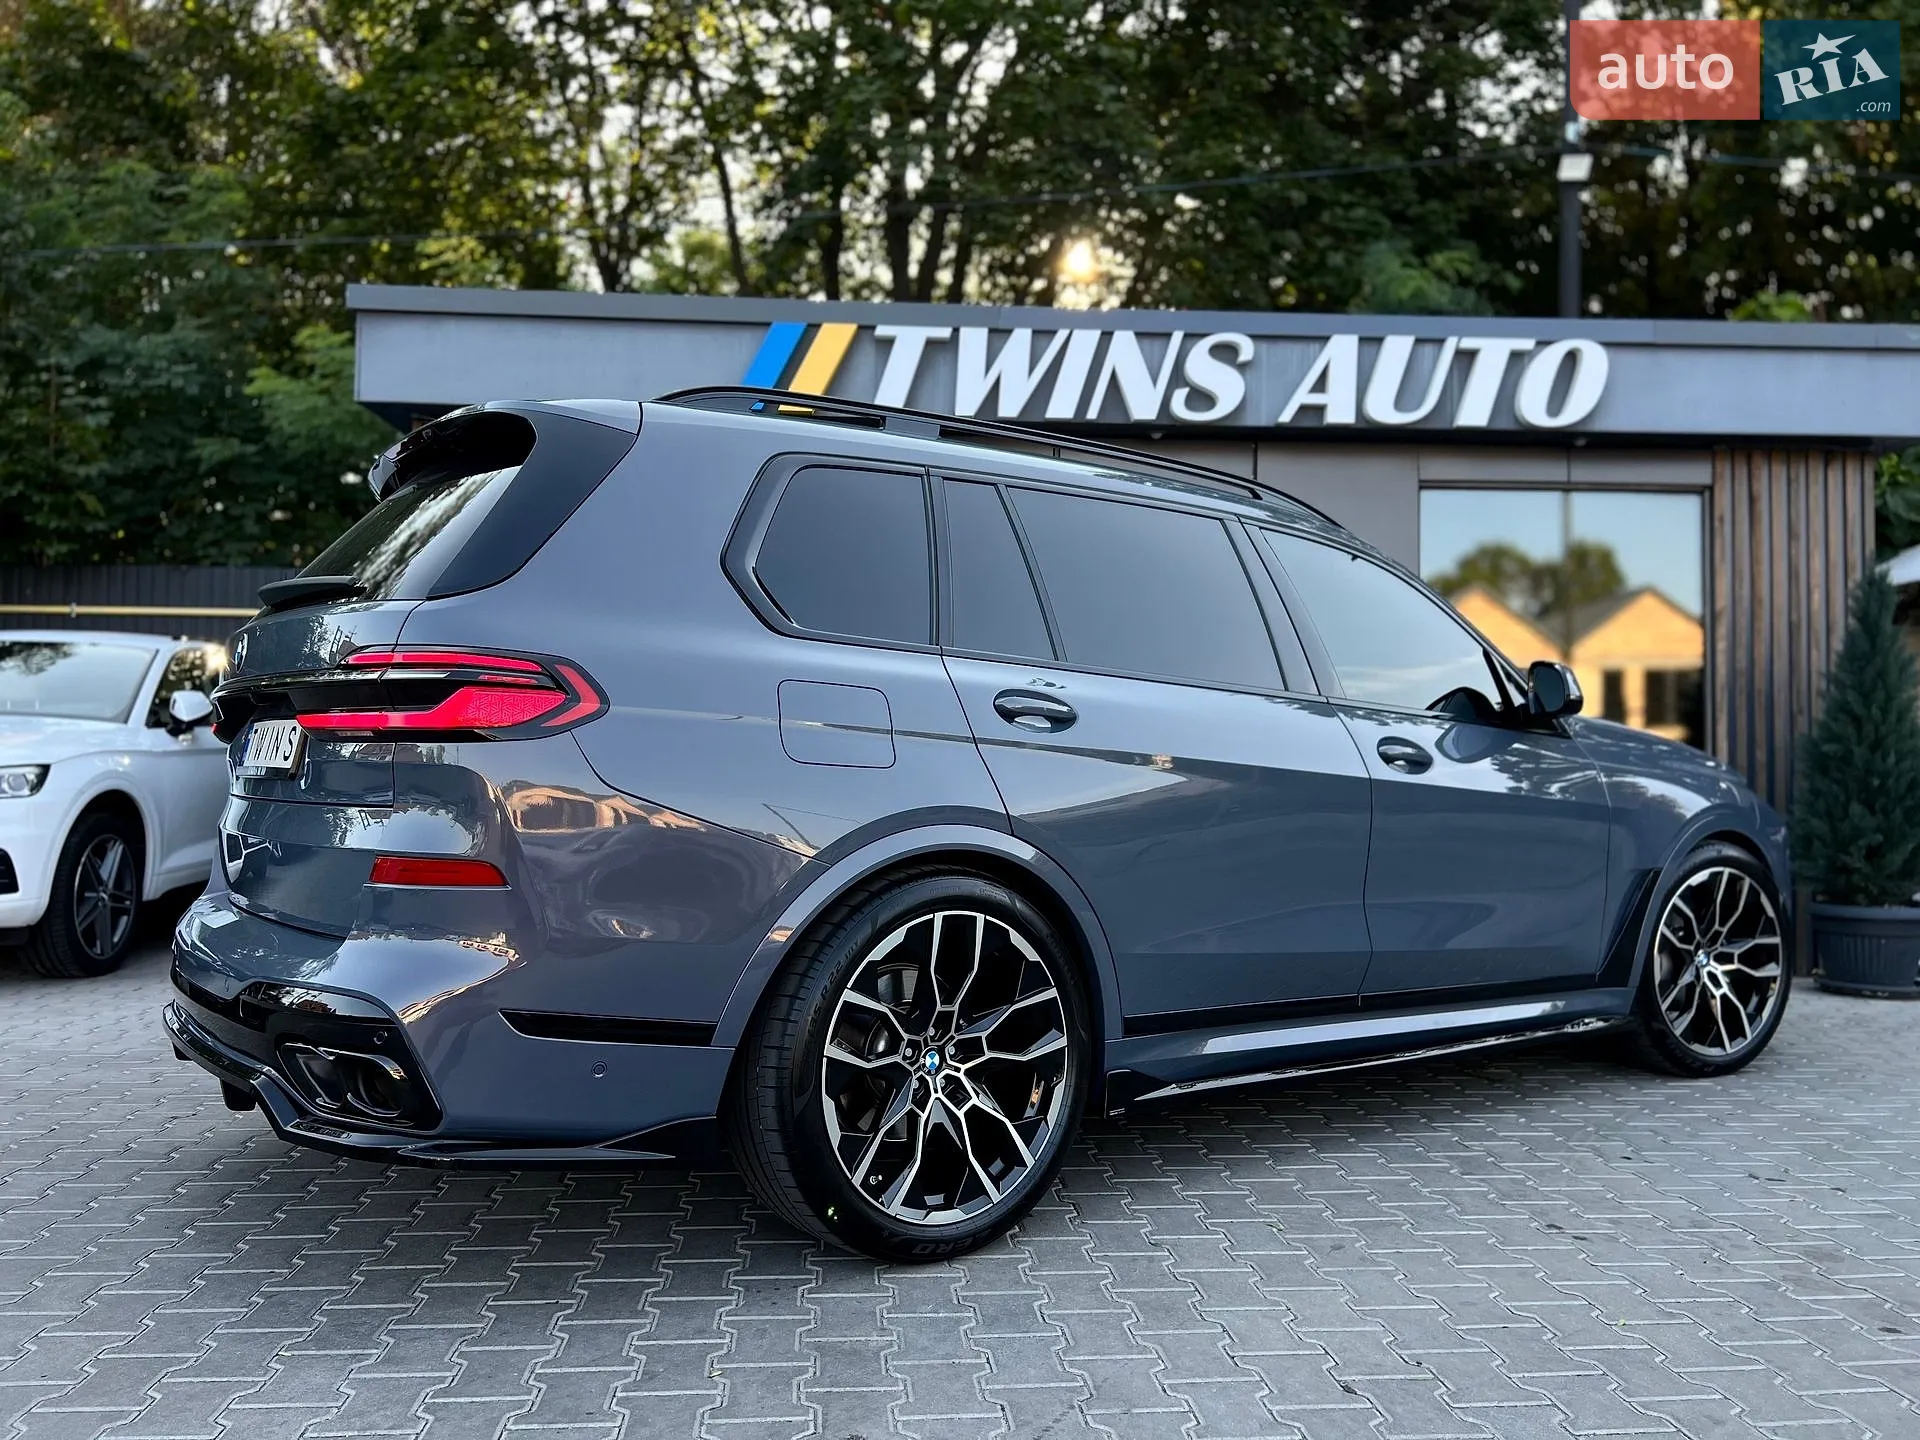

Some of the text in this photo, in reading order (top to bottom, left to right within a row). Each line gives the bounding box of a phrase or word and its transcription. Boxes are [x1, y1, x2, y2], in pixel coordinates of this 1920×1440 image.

[874, 325, 1610, 428] TWINS AUTO
[248, 725, 297, 762] TWINS
